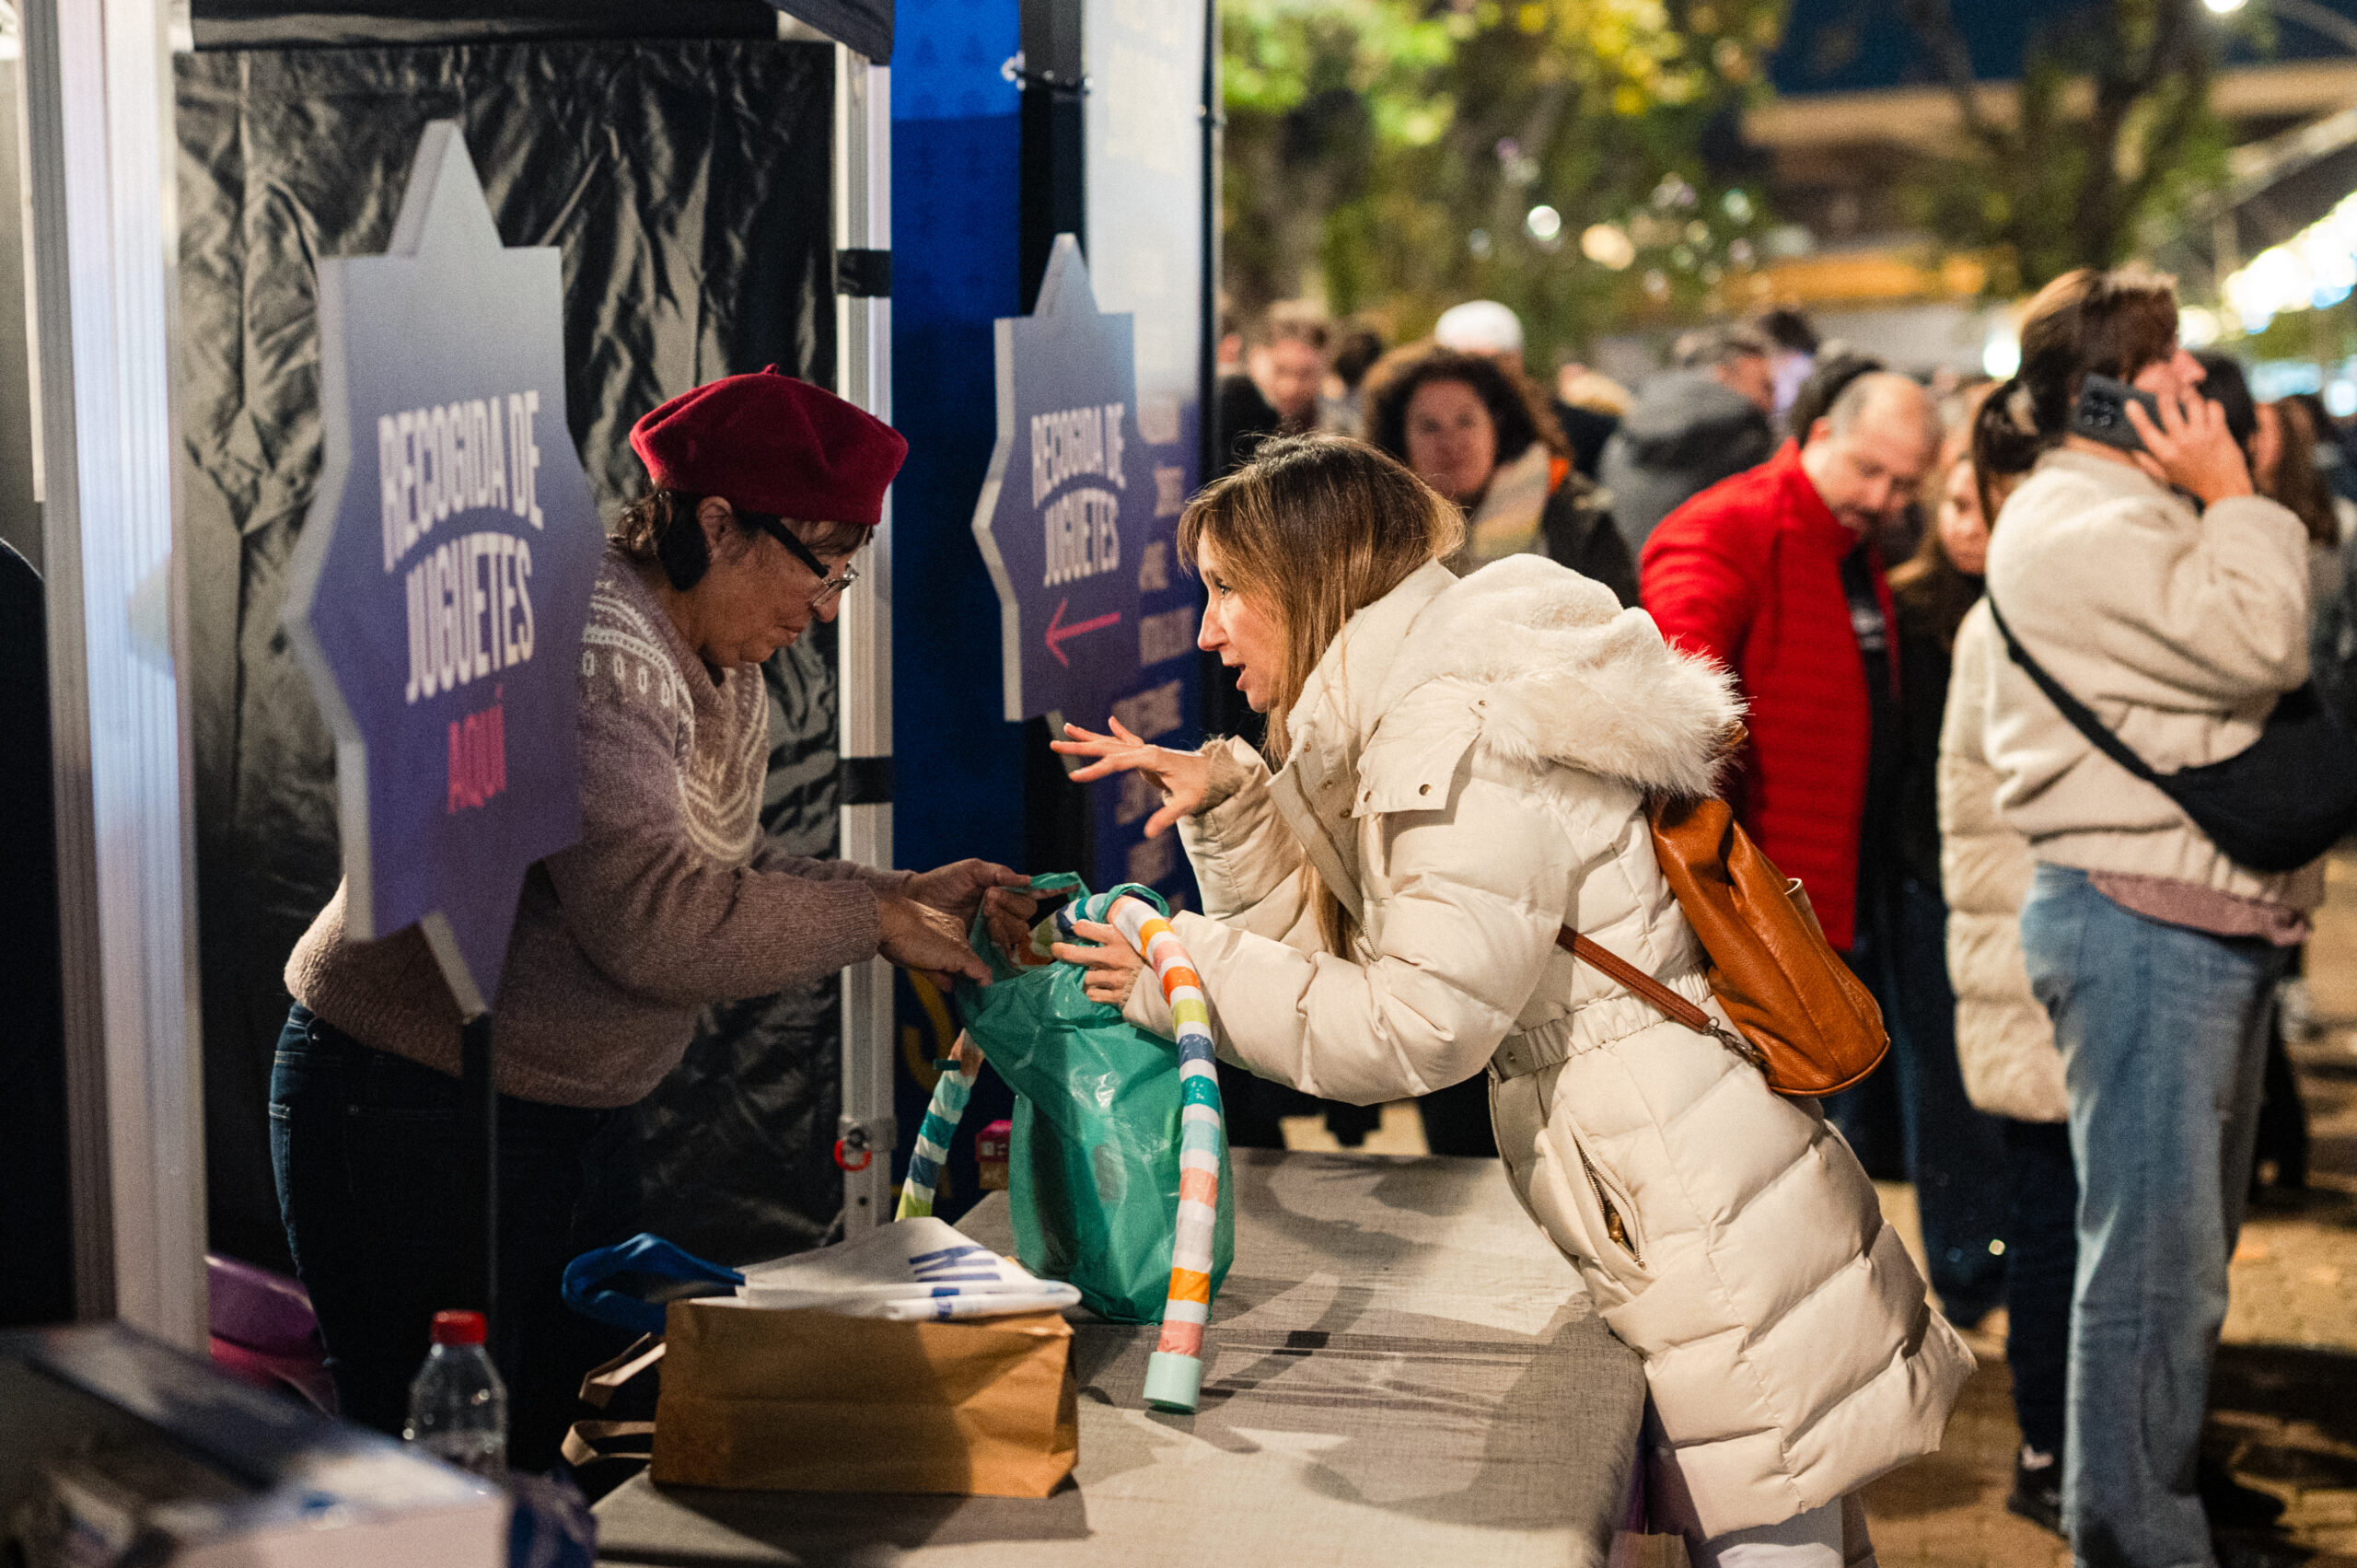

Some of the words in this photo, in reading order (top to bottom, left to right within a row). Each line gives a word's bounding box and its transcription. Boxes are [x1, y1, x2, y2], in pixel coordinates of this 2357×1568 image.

[379, 399, 506, 573] RECOGIDA
[508, 390, 544, 530] DE
[1031, 407, 1104, 509] RECOGIDA
[1105, 402, 1126, 490] DE
[1044, 488, 1120, 587] JUGUETES
[406, 532, 535, 703] JUGUETES
